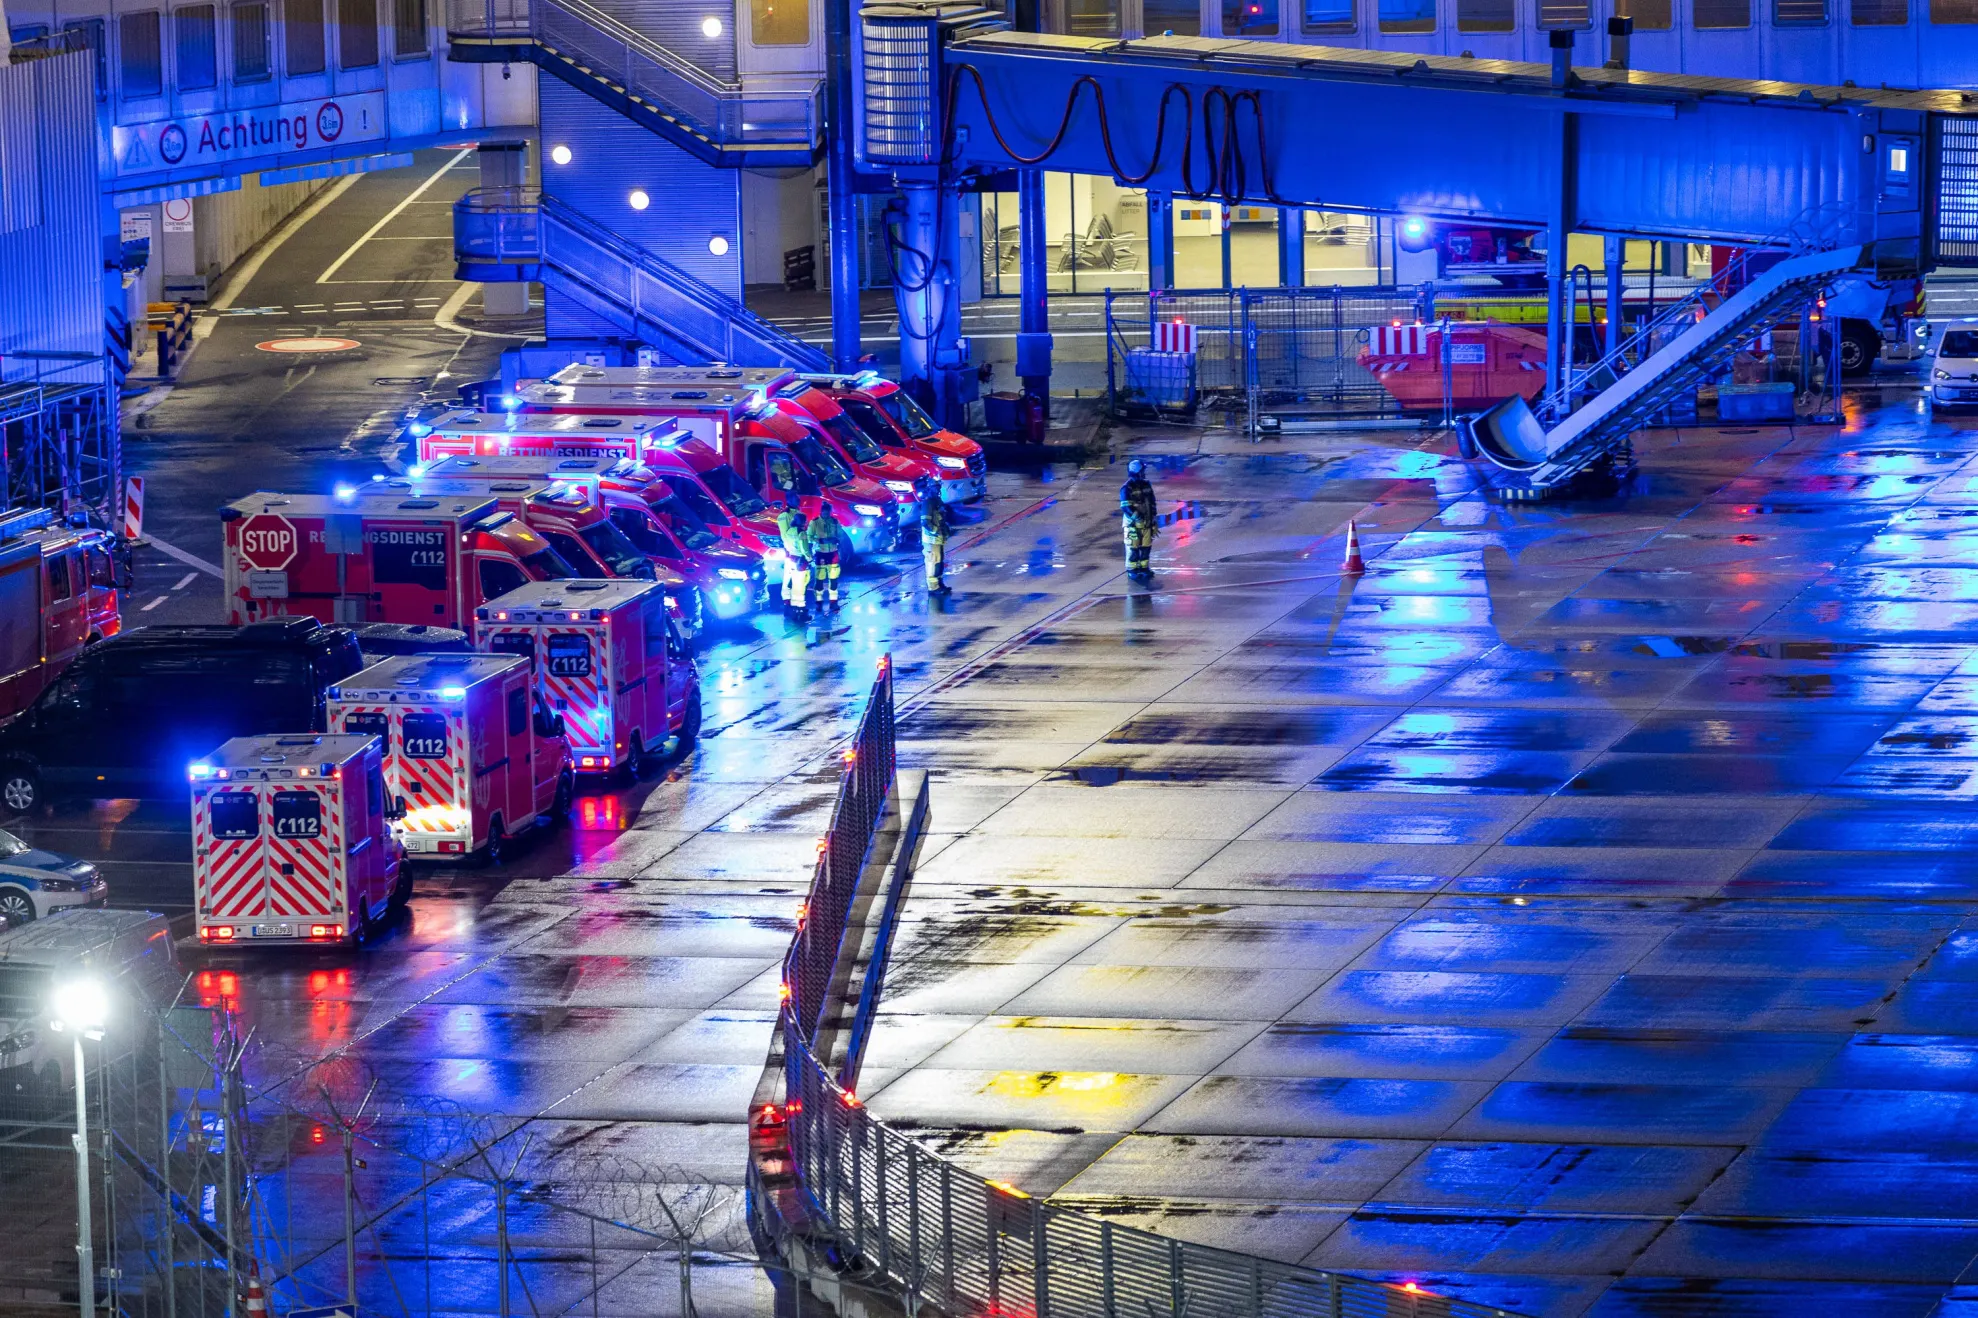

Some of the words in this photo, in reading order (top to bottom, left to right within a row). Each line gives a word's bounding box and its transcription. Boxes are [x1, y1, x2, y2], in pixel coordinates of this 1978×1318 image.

[198, 115, 308, 154] Achtung
[245, 530, 291, 552] STOP
[309, 530, 444, 545] RENGSDIENST
[420, 551, 445, 564] 112
[561, 657, 588, 671] 112
[416, 738, 444, 753] 112
[288, 817, 318, 833] 112
